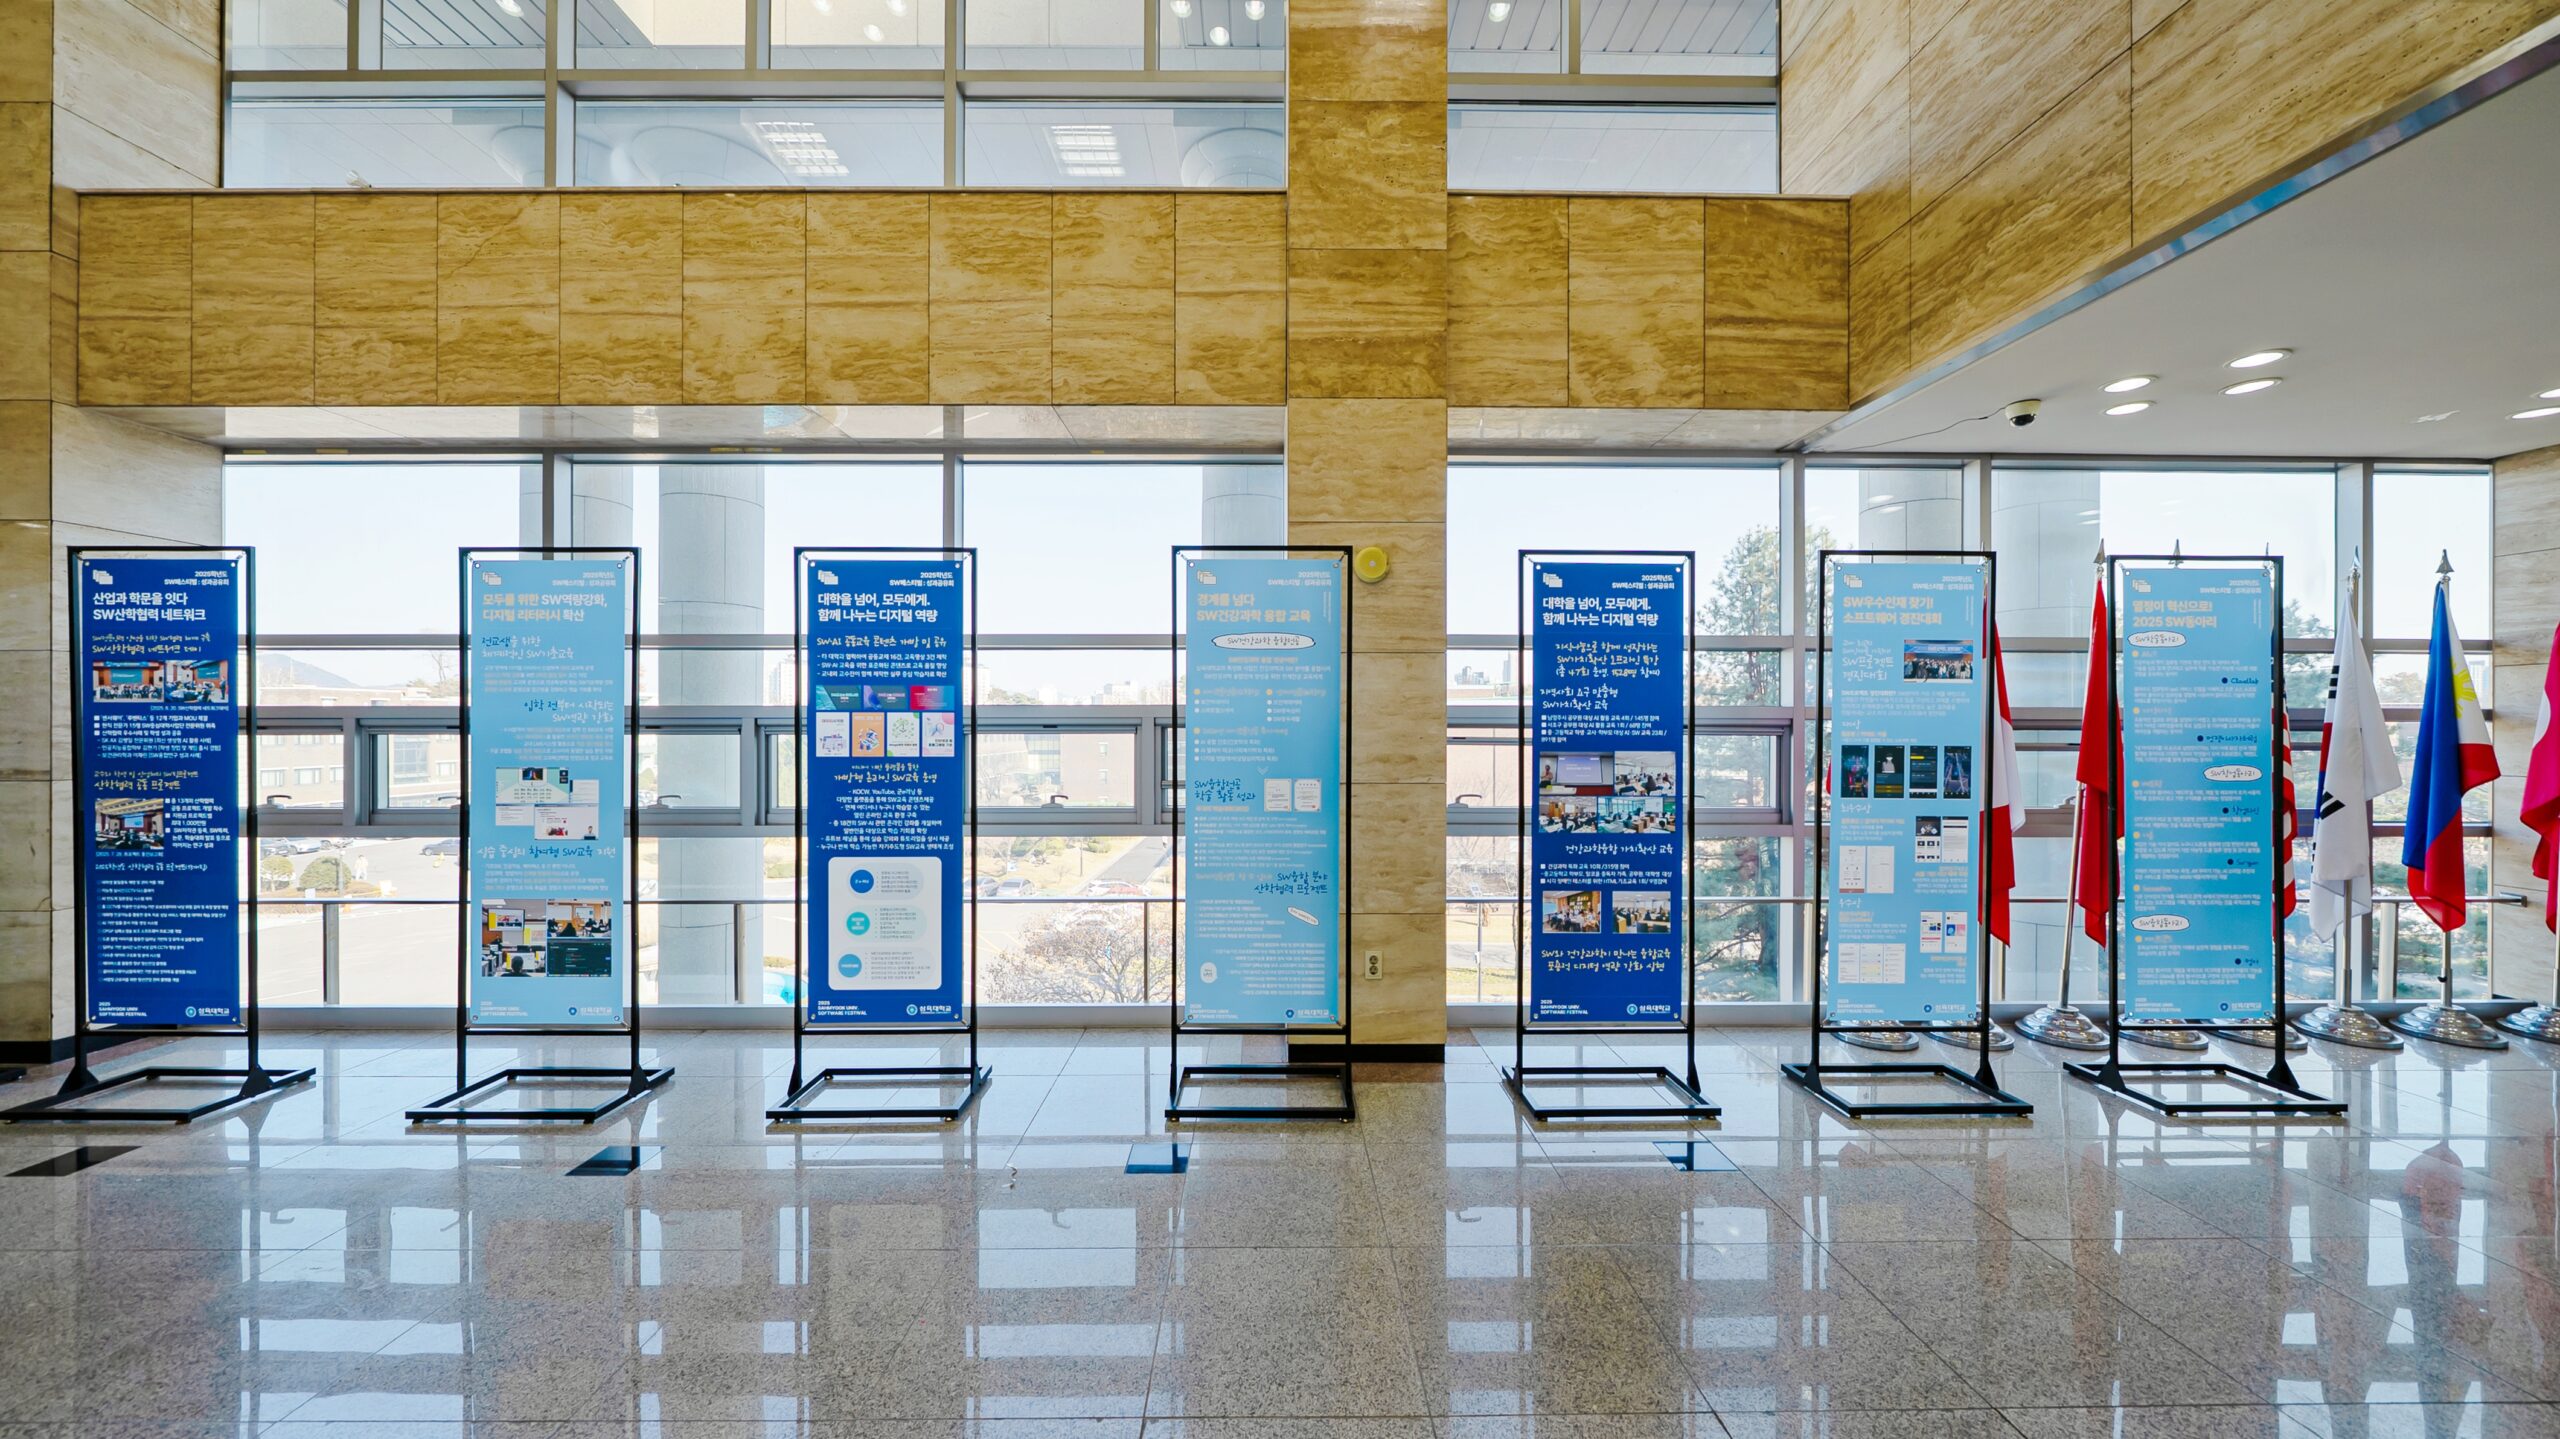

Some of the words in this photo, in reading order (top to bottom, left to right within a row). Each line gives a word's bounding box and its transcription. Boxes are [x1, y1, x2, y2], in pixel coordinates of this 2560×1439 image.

[94, 592, 127, 605] 산업과
[129, 592, 163, 605] 학문을
[165, 592, 188, 605] 잇다
[484, 594, 515, 606] 모두를
[518, 594, 540, 606] 위한
[542, 594, 607, 606] SW역량강화,
[818, 593, 852, 606] 대학을
[855, 593, 880, 606] 넘어,
[882, 593, 930, 606] 모두에게.
[1543, 598, 1575, 610] 대학을
[1578, 598, 1602, 610] 넘어,
[1605, 598, 1651, 610] 모두에게.
[1843, 596, 1907, 609] SW우수인재
[2133, 600, 2164, 613] 열정이
[94, 608, 158, 621] SW산학협력
[161, 608, 206, 621] 네트워크
[483, 609, 516, 622] 디지털
[517, 609, 560, 622] 리터러시
[563, 609, 584, 622] 확산
[818, 609, 841, 622] 함께
[843, 609, 877, 622] 나누는
[880, 609, 912, 622] 디지털
[915, 609, 938, 622] 역량
[1197, 610, 1262, 622] SW건강과학
[1264, 610, 1286, 622] 융합
[1289, 610, 1311, 622] 교육
[1543, 613, 1564, 626] 함께
[1567, 613, 1600, 626] 나누는
[1602, 613, 1634, 626] 디지털
[1636, 613, 1658, 626] 역량
[1844, 612, 1897, 624] 소프트웨어
[1900, 612, 1942, 624] 경진대회
[2133, 616, 2163, 628] 2025
[2165, 616, 2216, 628] SW동아리
[845, 636, 870, 648] 공동교육
[1602, 642, 1620, 654] 함께
[1624, 642, 1657, 654] 성장하는
[1540, 686, 1573, 698] 지역사회
[1577, 686, 1589, 698] 요구
[1543, 698, 1591, 710] SW가치확산
[1595, 698, 1608, 710] 교육
[835, 772, 863, 783] 개방형
[867, 772, 889, 783] 온라인
[892, 772, 918, 783] SW교육
[923, 772, 937, 783] 운영
[1195, 778, 1240, 792] SW융합전공
[1196, 790, 1212, 802] 학술
[1217, 790, 1233, 802] 활동
[1237, 790, 1256, 802] 성과
[563, 845, 592, 858] SW교육
[1566, 844, 1617, 854] 건강과학융합
[1621, 844, 1656, 854] 가치확산
[1660, 844, 1672, 854] 교육
[1278, 871, 1309, 884] SW융합
[1313, 871, 1328, 884] 분야
[1255, 882, 1293, 895] 산학협력
[1298, 882, 1328, 895] 프로젝트
[1568, 948, 1610, 962] 건강과학이
[1641, 948, 1670, 962] 융합교육
